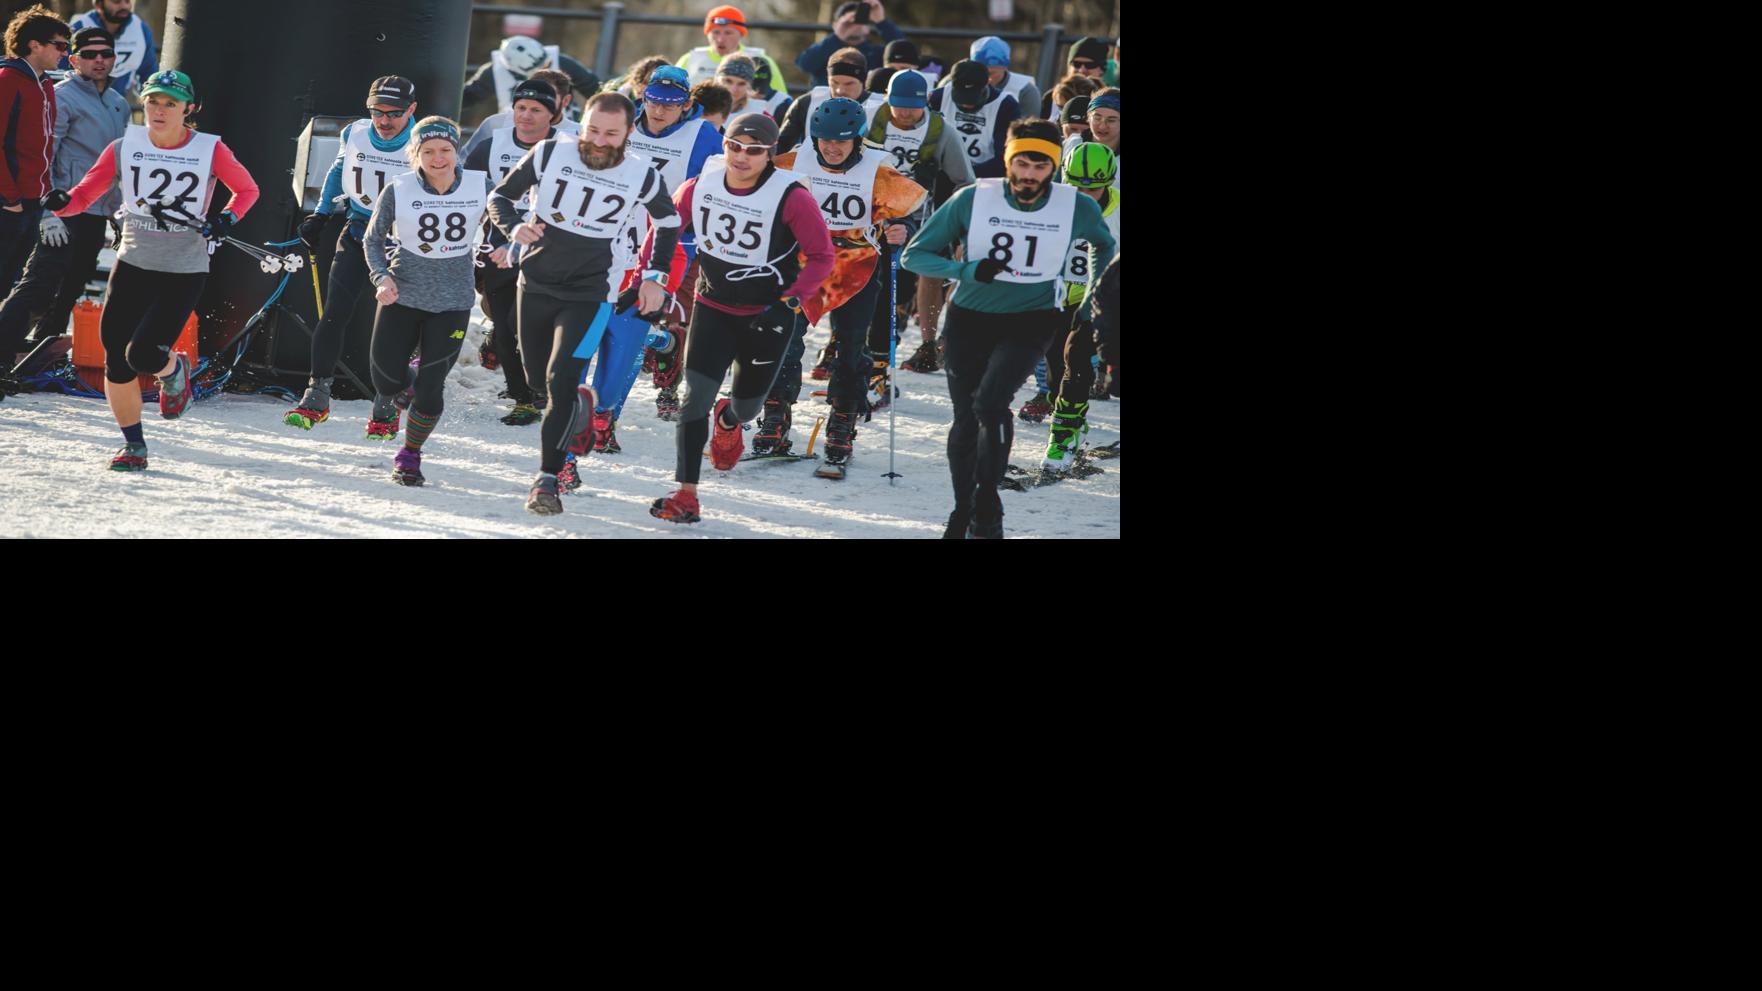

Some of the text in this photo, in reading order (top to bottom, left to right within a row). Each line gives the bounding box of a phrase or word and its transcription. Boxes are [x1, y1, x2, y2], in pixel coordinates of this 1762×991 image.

[130, 166, 199, 202] 122
[551, 179, 625, 224] 112
[821, 192, 866, 220] 40
[418, 212, 467, 242] 88
[700, 206, 763, 250] 135
[988, 232, 1038, 267] 81
